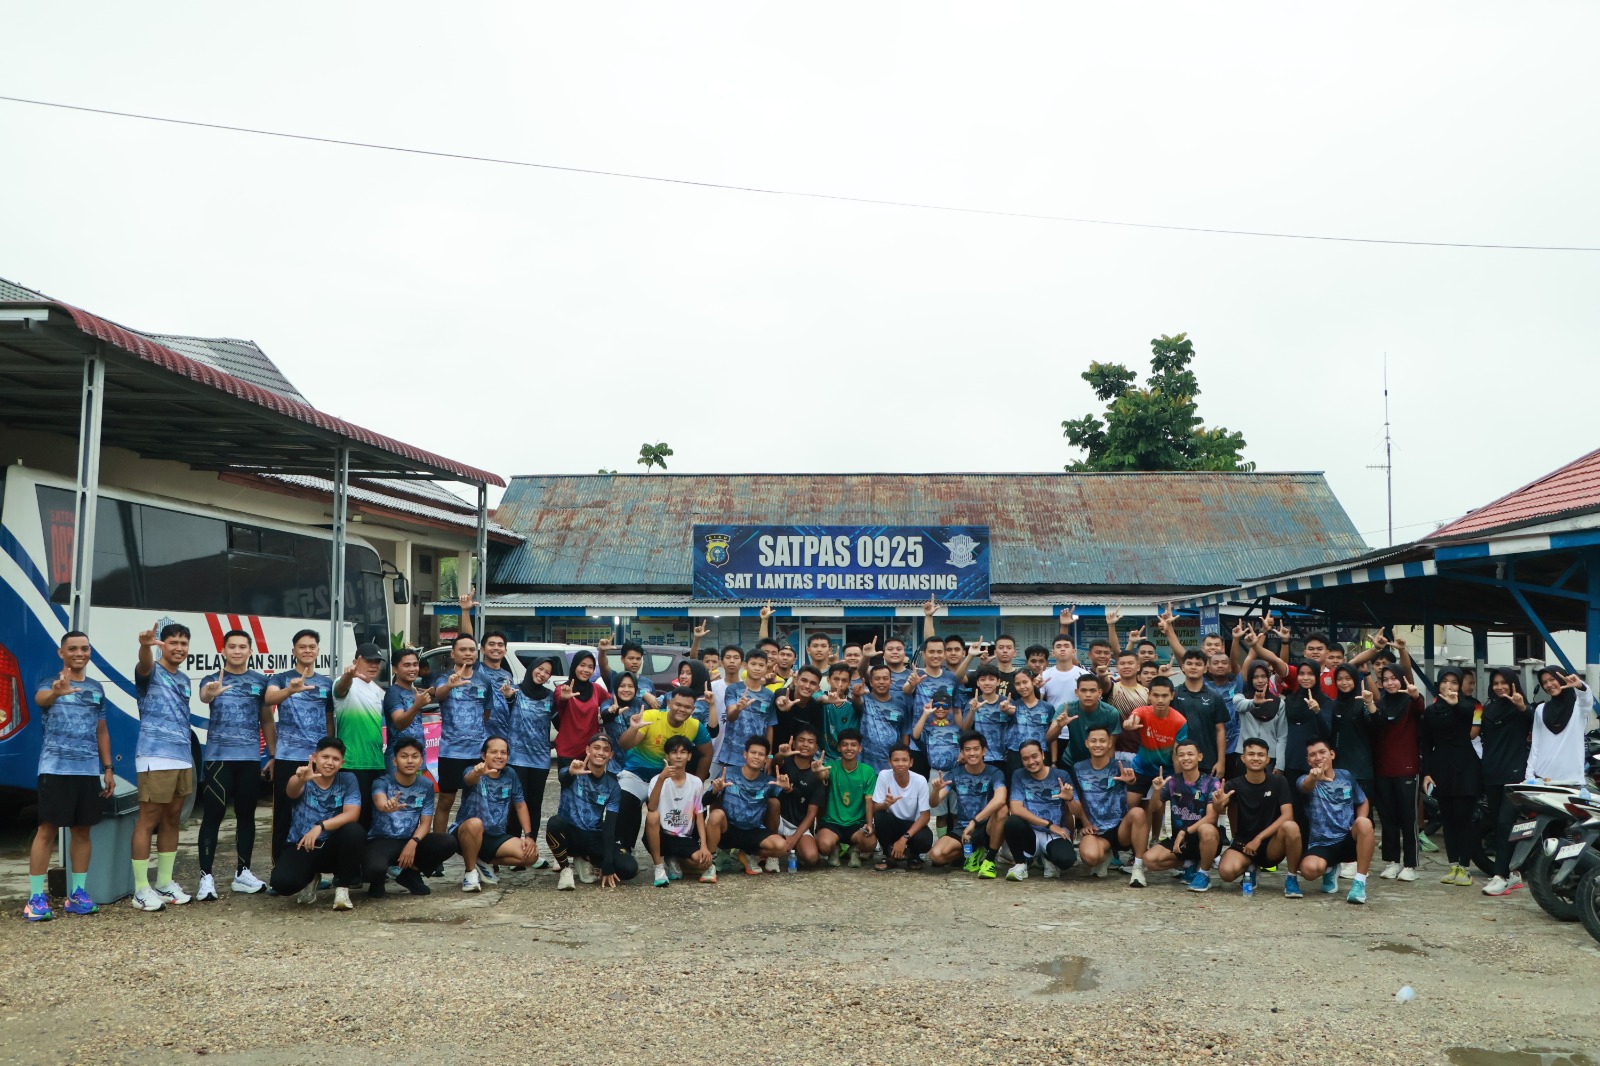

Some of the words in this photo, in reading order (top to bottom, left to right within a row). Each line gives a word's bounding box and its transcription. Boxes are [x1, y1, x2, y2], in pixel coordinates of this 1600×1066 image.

[49, 509, 76, 523] SATPA
[758, 534, 850, 568] SATPAS
[857, 535, 924, 568] 0925
[724, 573, 754, 589] SAT
[757, 574, 813, 590] LANTAS
[816, 574, 874, 590] POLRES
[877, 574, 958, 591] KUANSING
[187, 653, 263, 670] PELAYAN
[267, 654, 288, 669] SIM
[842, 791, 850, 806] 5
